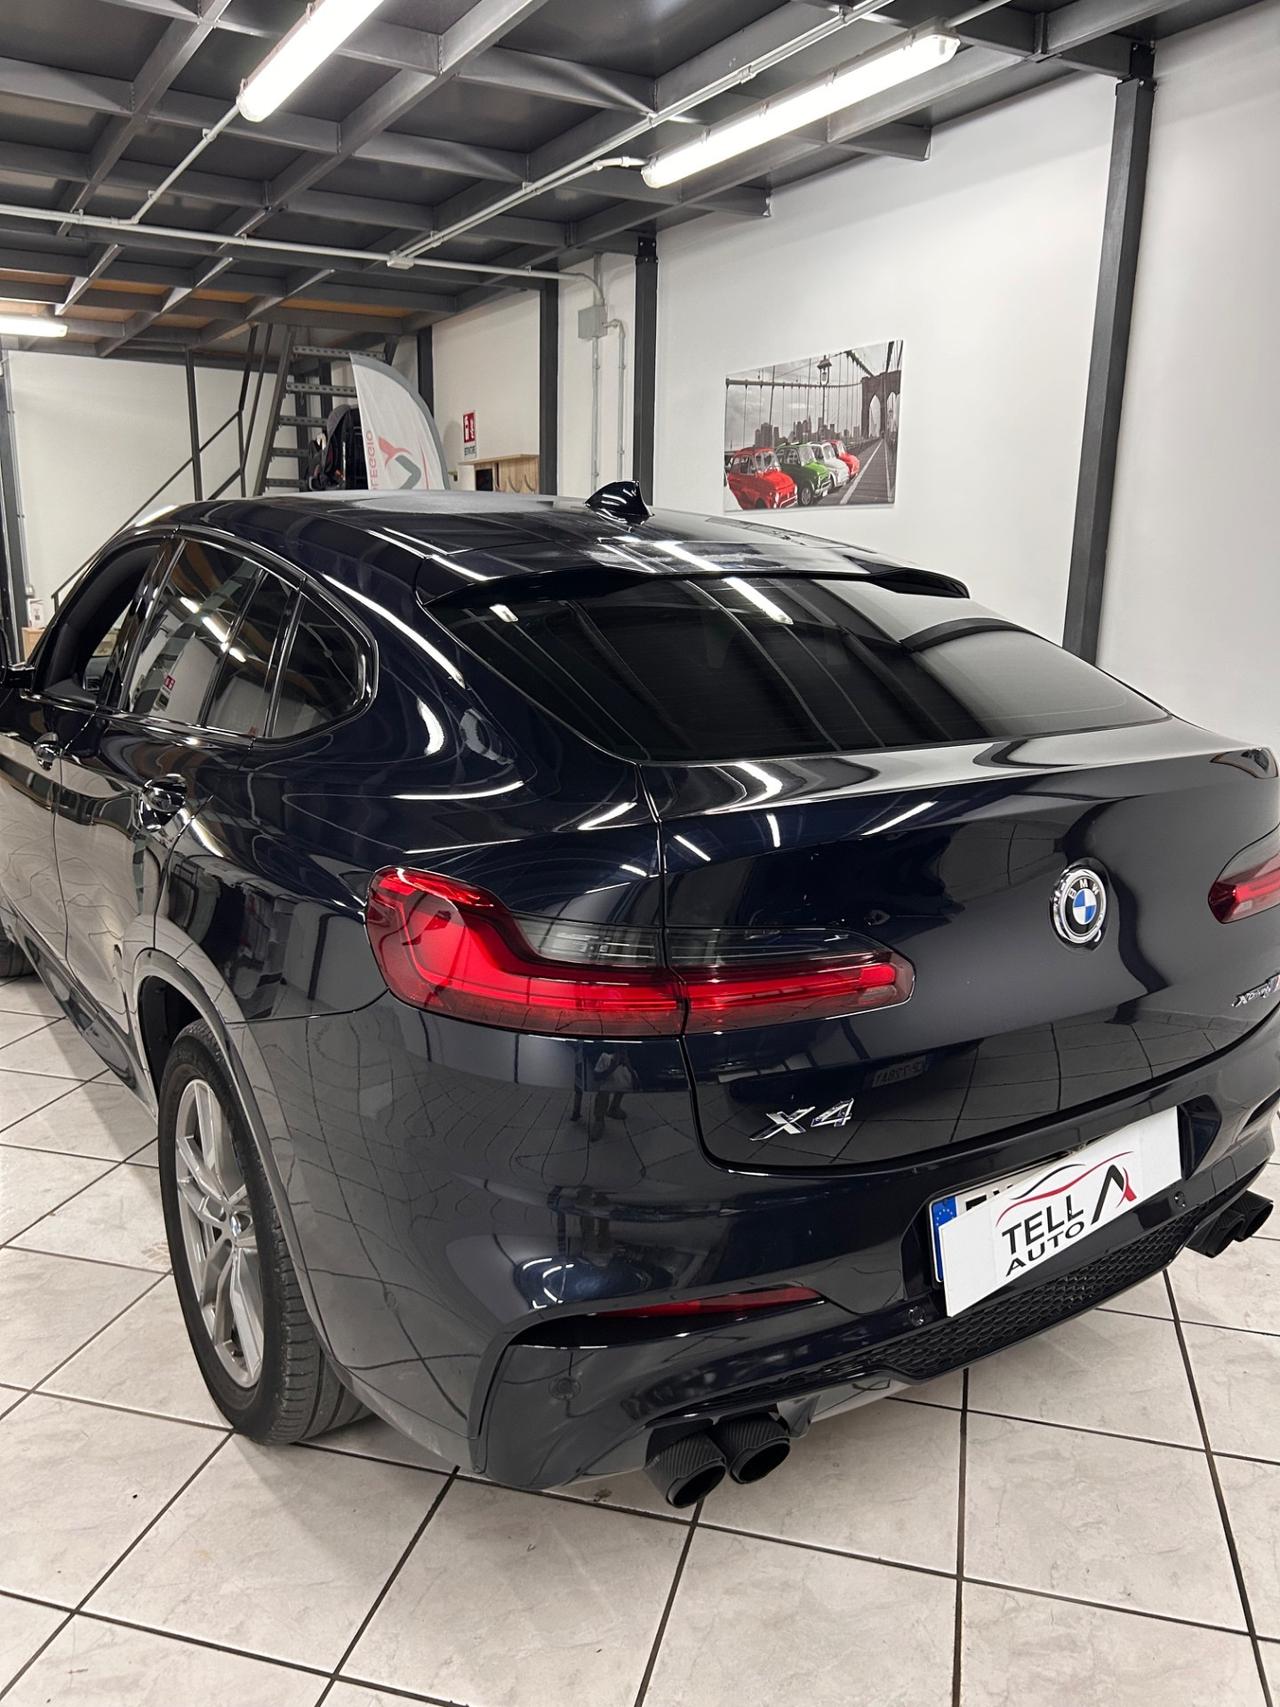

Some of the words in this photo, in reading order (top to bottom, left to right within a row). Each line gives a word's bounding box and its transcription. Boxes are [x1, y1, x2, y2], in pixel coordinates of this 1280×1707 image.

[1067, 878, 1100, 899] BMW
[750, 1098, 854, 1141] X4
[1005, 1221, 1085, 1277] AUTO
